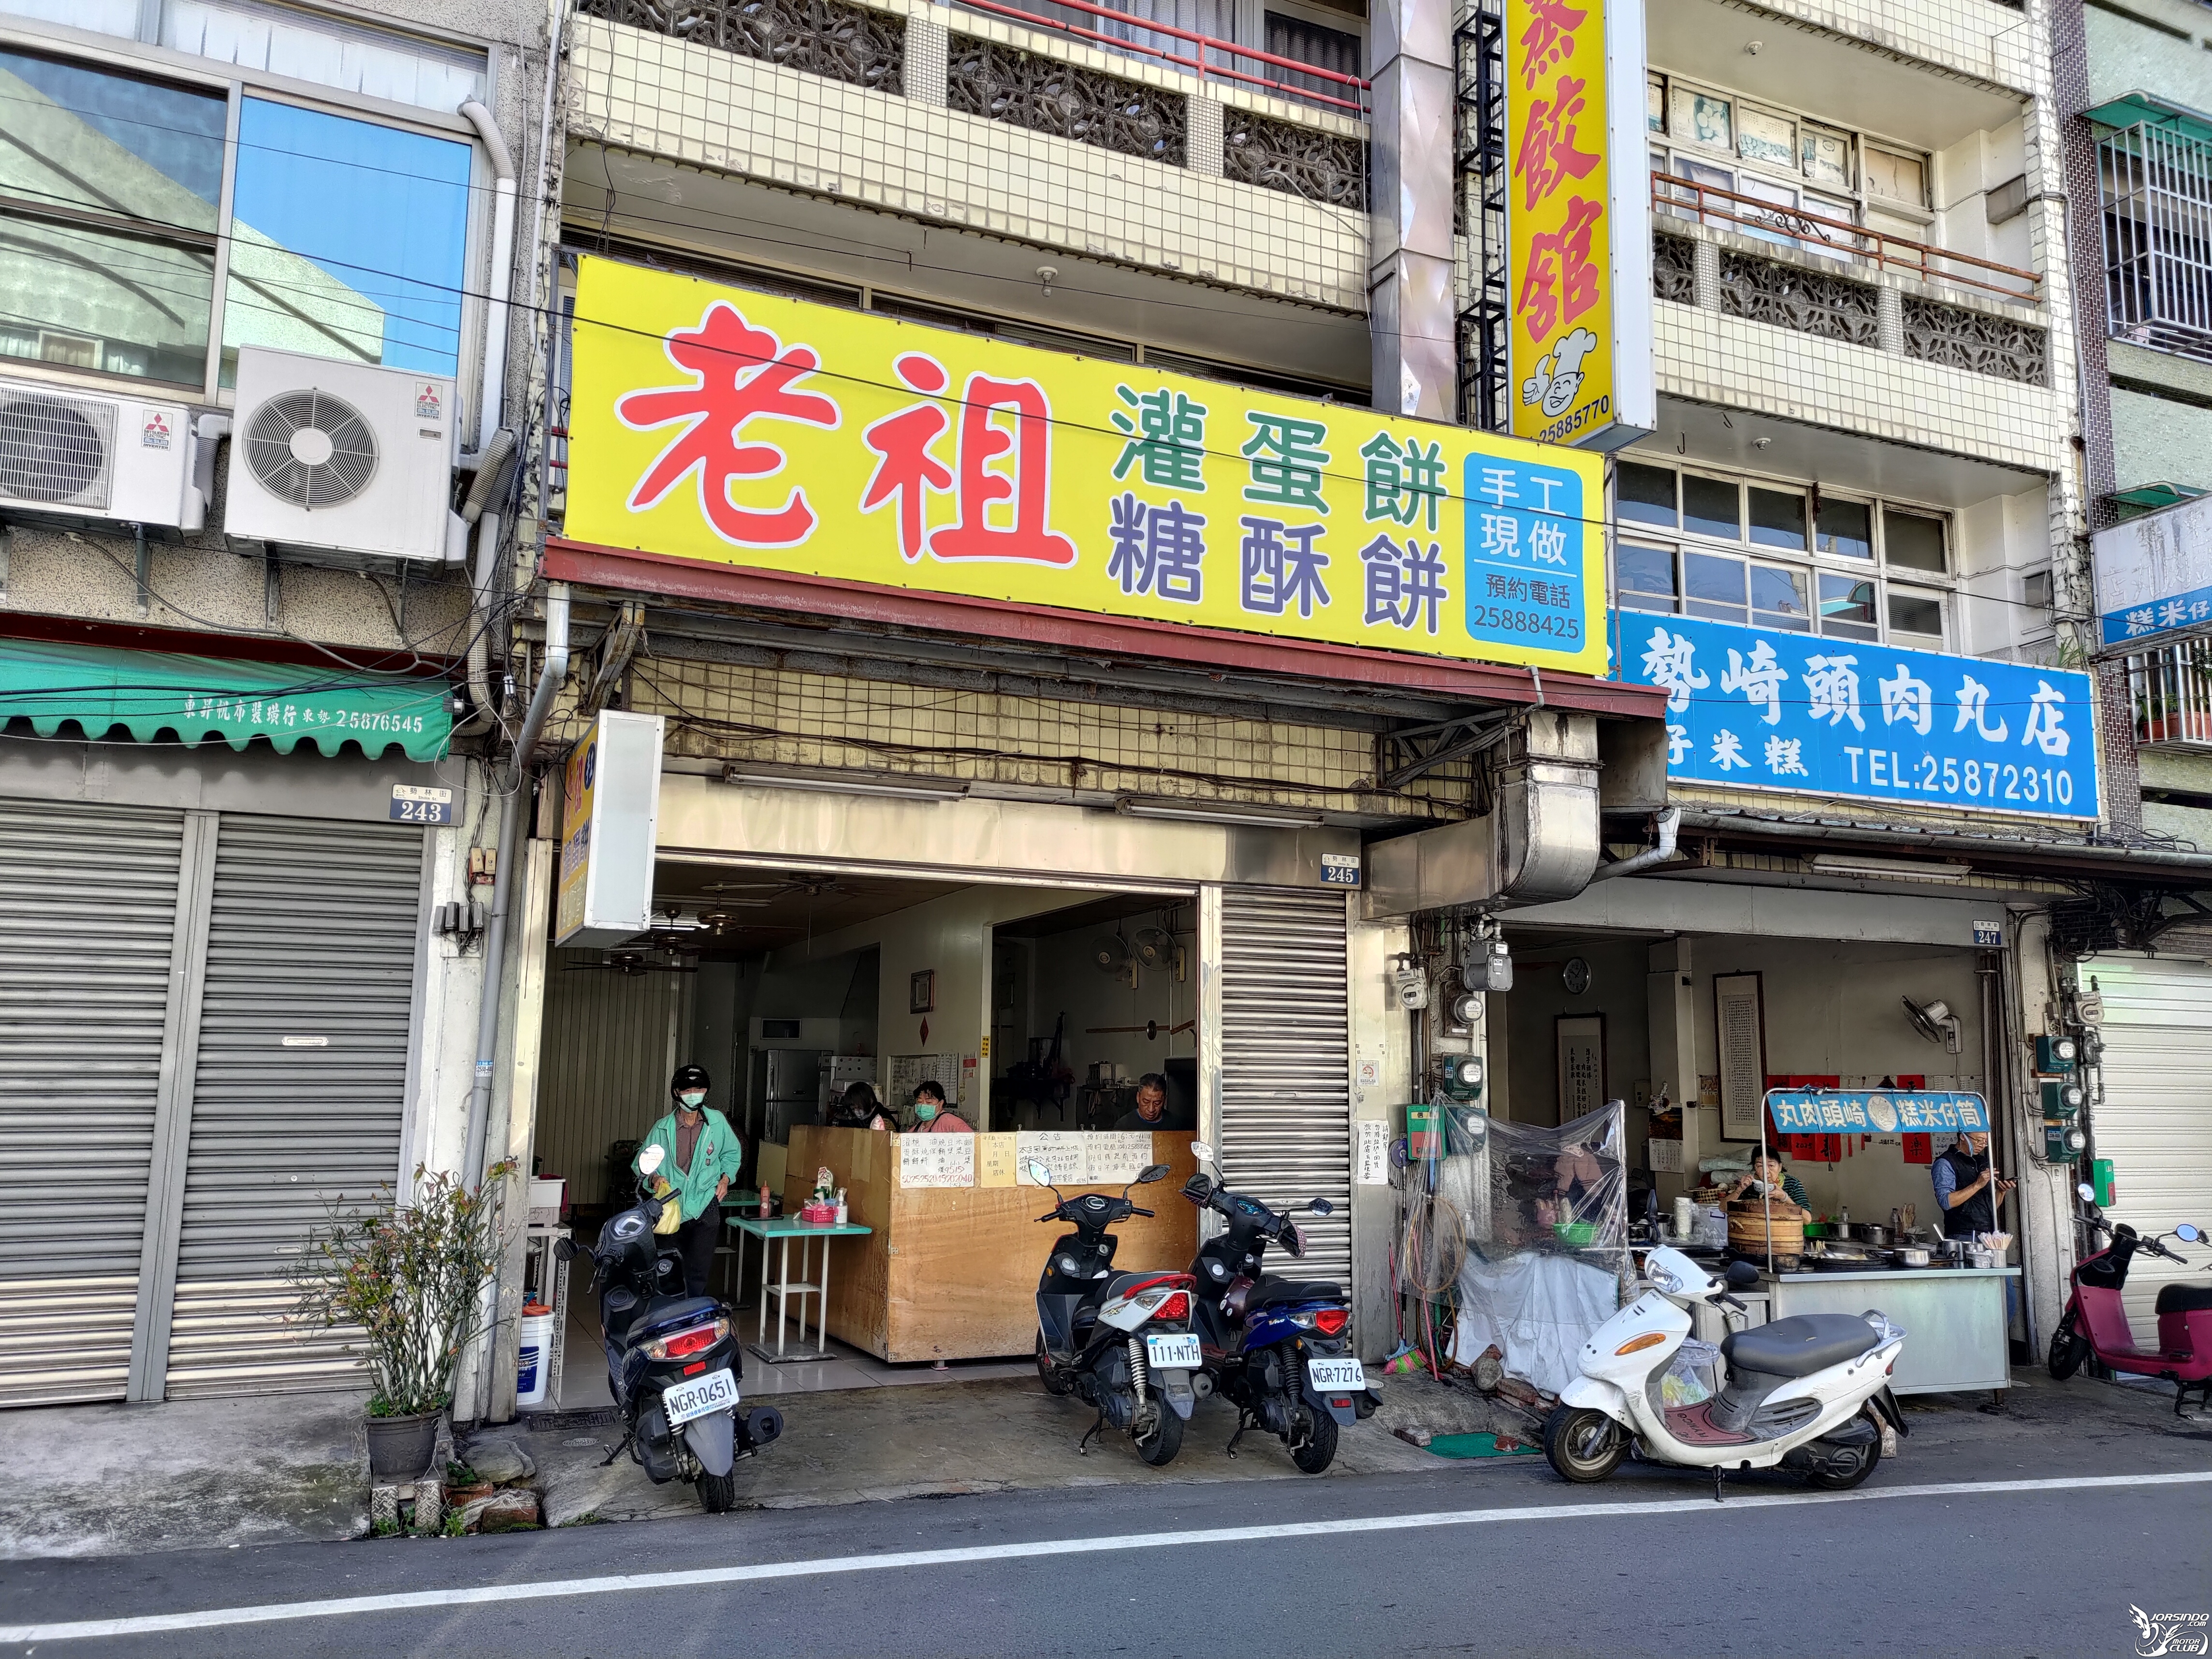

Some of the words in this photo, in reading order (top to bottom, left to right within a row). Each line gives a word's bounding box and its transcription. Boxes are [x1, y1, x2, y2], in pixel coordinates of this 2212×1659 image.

[616, 301, 1077, 564] 老祖
[1111, 384, 1448, 533] 灌蛋餅
[1480, 468, 1567, 516] 手工
[1480, 514, 1568, 566] 現做
[1107, 491, 1448, 634] 糖酥餅
[1485, 573, 1571, 610] 預約電話
[1473, 605, 1579, 639] 25888425
[1607, 626, 2070, 757] 勢崎頭肉丸店
[336, 710, 422, 733] 25876545
[1843, 745, 2073, 806] TEL:25872310
[400, 801, 441, 822] 243
[1328, 866, 1354, 883] 245
[1979, 931, 1996, 944] 247
[1039, 1133, 1061, 1141] 公告
[1152, 1345, 1200, 1362] 111-NTH
[1311, 1367, 1362, 1383] NGR-7276
[669, 1378, 732, 1415] NGR-0651
